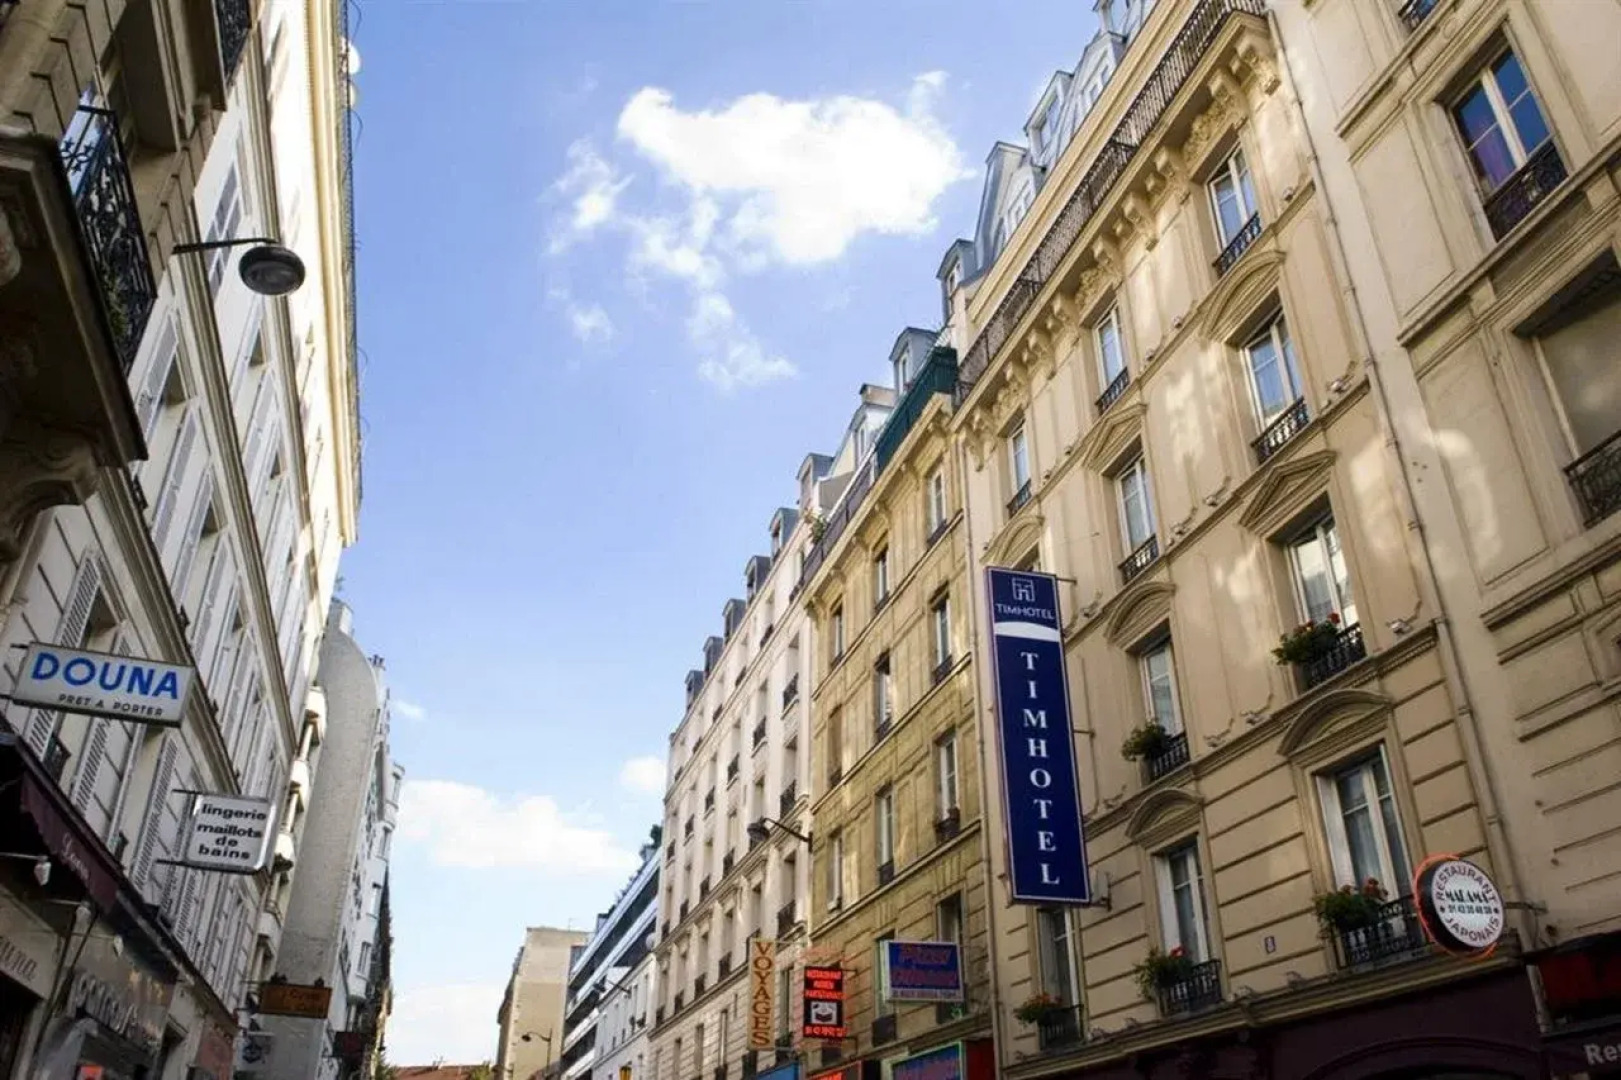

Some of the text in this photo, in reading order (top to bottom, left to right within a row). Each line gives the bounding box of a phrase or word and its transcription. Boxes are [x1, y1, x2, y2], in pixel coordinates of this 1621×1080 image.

[995, 603, 1056, 620] TIMHOTEL
[31, 652, 178, 700] DOUNA
[58, 693, 91, 706] PRET
[112, 702, 163, 717] PORTER
[1020, 651, 1060, 885] TIMHOTEL
[201, 803, 266, 820] lingerie
[197, 824, 263, 838] maillots
[215, 836, 238, 847] de
[199, 844, 250, 859] bains
[1435, 865, 1497, 901] RESTAURANT
[1444, 916, 1500, 942] JAPONAIS
[752, 941, 773, 1046] VOYAGES
[1583, 1042, 1621, 1066] Re
